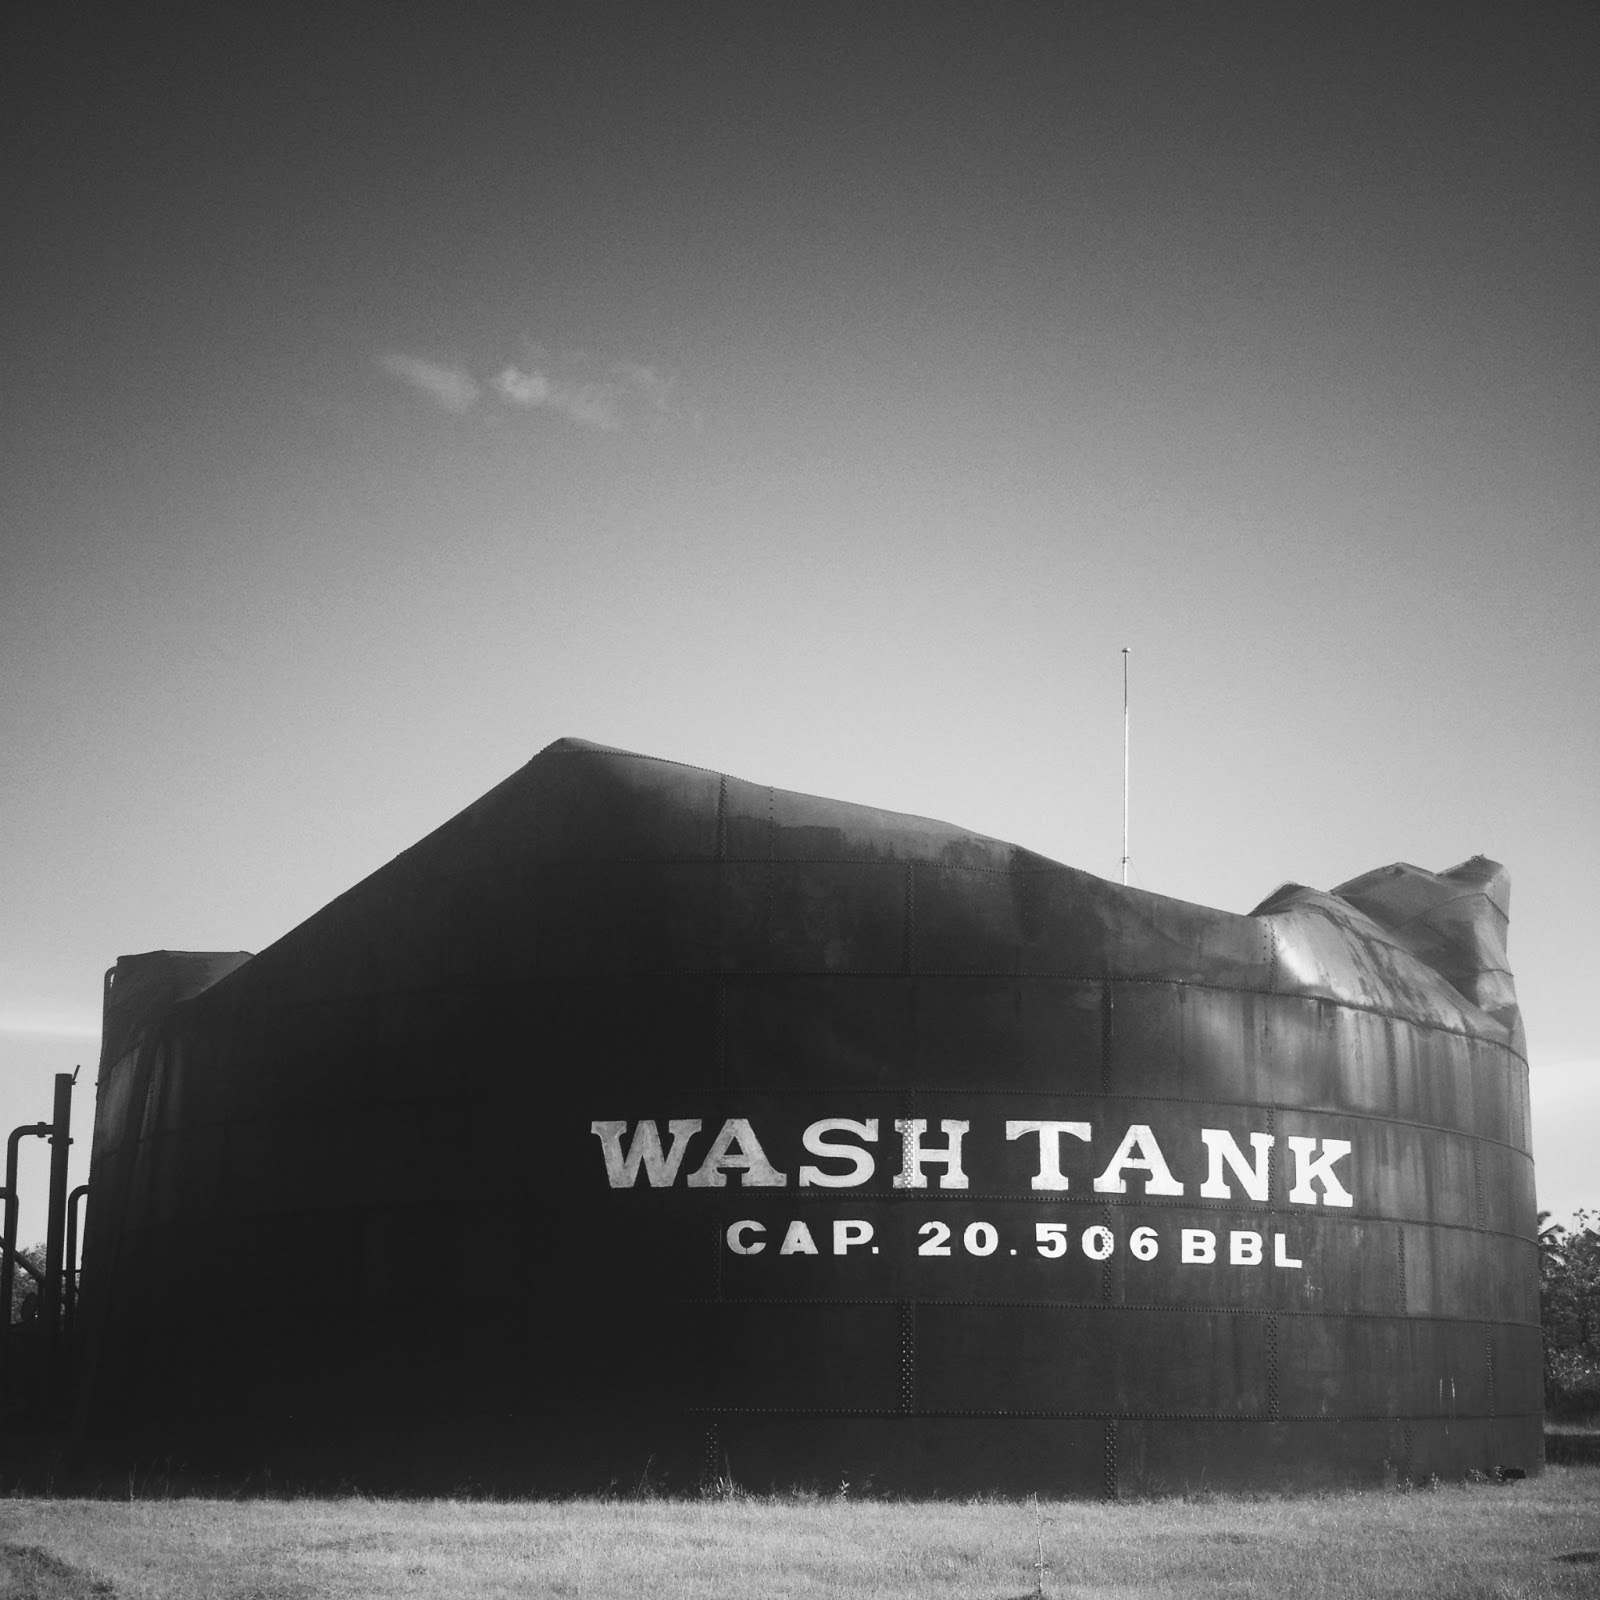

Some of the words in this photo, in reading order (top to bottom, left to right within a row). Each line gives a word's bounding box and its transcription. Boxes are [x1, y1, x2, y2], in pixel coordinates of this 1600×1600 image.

[590, 1118, 970, 1189] WASH
[1005, 1120, 1355, 1208] TANK
[726, 1219, 880, 1256] CAP.
[917, 1220, 1160, 1262] 20.506
[1180, 1228, 1304, 1269] BBL
